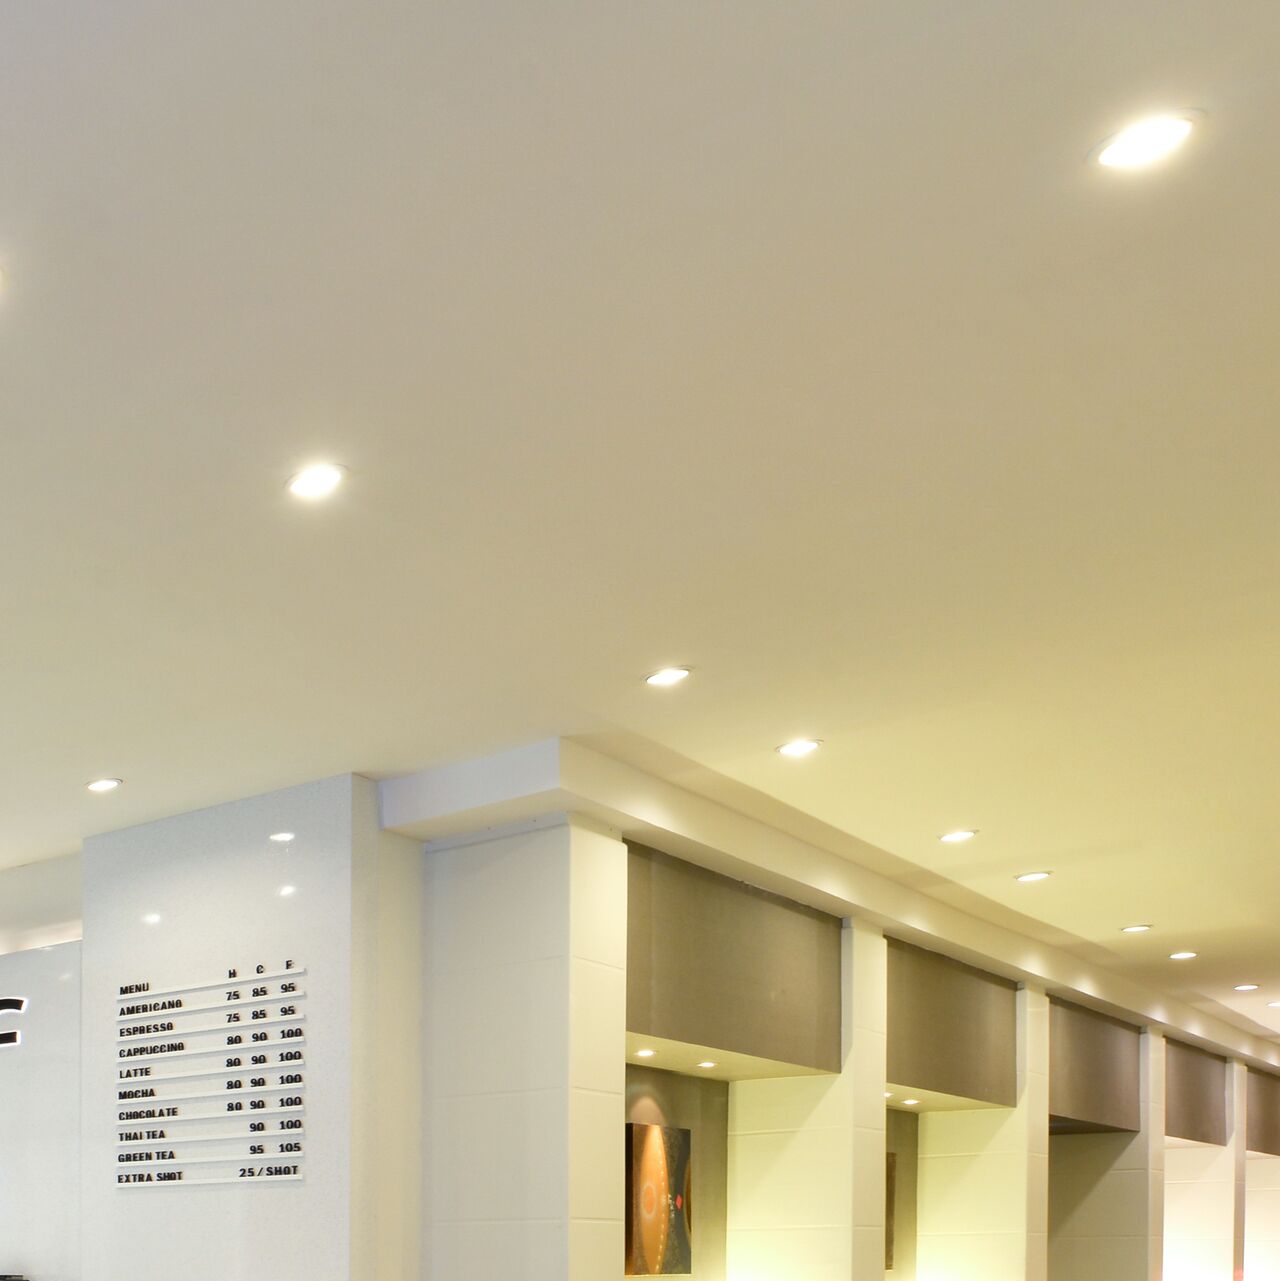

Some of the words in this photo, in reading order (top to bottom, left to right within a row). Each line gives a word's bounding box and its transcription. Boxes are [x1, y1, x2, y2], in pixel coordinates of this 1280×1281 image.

[120, 983, 150, 995] MENU
[228, 969, 237, 979] H
[286, 960, 293, 970] F
[119, 999, 182, 1016] AMERICANO
[226, 991, 240, 1001] 75
[252, 987, 267, 997] 85
[281, 983, 294, 993] 95
[119, 1022, 173, 1037] ESPRESSO
[226, 1013, 240, 1023] 75
[252, 1010, 267, 1020] 85
[280, 1006, 294, 1016] 95
[119, 1042, 184, 1058] CAPPUCCINO
[227, 1035, 241, 1045] 80
[252, 1032, 267, 1042] 90
[280, 1028, 302, 1039] 100
[119, 1068, 151, 1079] LATTE
[226, 1058, 241, 1067] 80
[252, 1055, 266, 1064] 90
[279, 1051, 301, 1062] 100
[119, 1089, 155, 1099] MOCHA
[227, 1080, 241, 1090] 80
[251, 1078, 265, 1087] 90
[279, 1074, 302, 1085] 100
[119, 1107, 178, 1121] CHOCOLATE
[227, 1102, 242, 1111] 80
[250, 1100, 265, 1110] 90
[279, 1097, 301, 1107] 100
[119, 1131, 143, 1141] THAI
[146, 1130, 165, 1140] TEA
[249, 1123, 265, 1132] 90
[280, 1120, 301, 1130] 100
[118, 1152, 152, 1163] GREEN
[155, 1151, 175, 1160] TEA
[249, 1145, 264, 1155] 95
[279, 1143, 300, 1153] 105
[118, 1174, 152, 1183] EXTRA
[156, 1172, 182, 1181] SHOT
[240, 1168, 254, 1177] 25
[266, 1165, 298, 1176] SHOT
